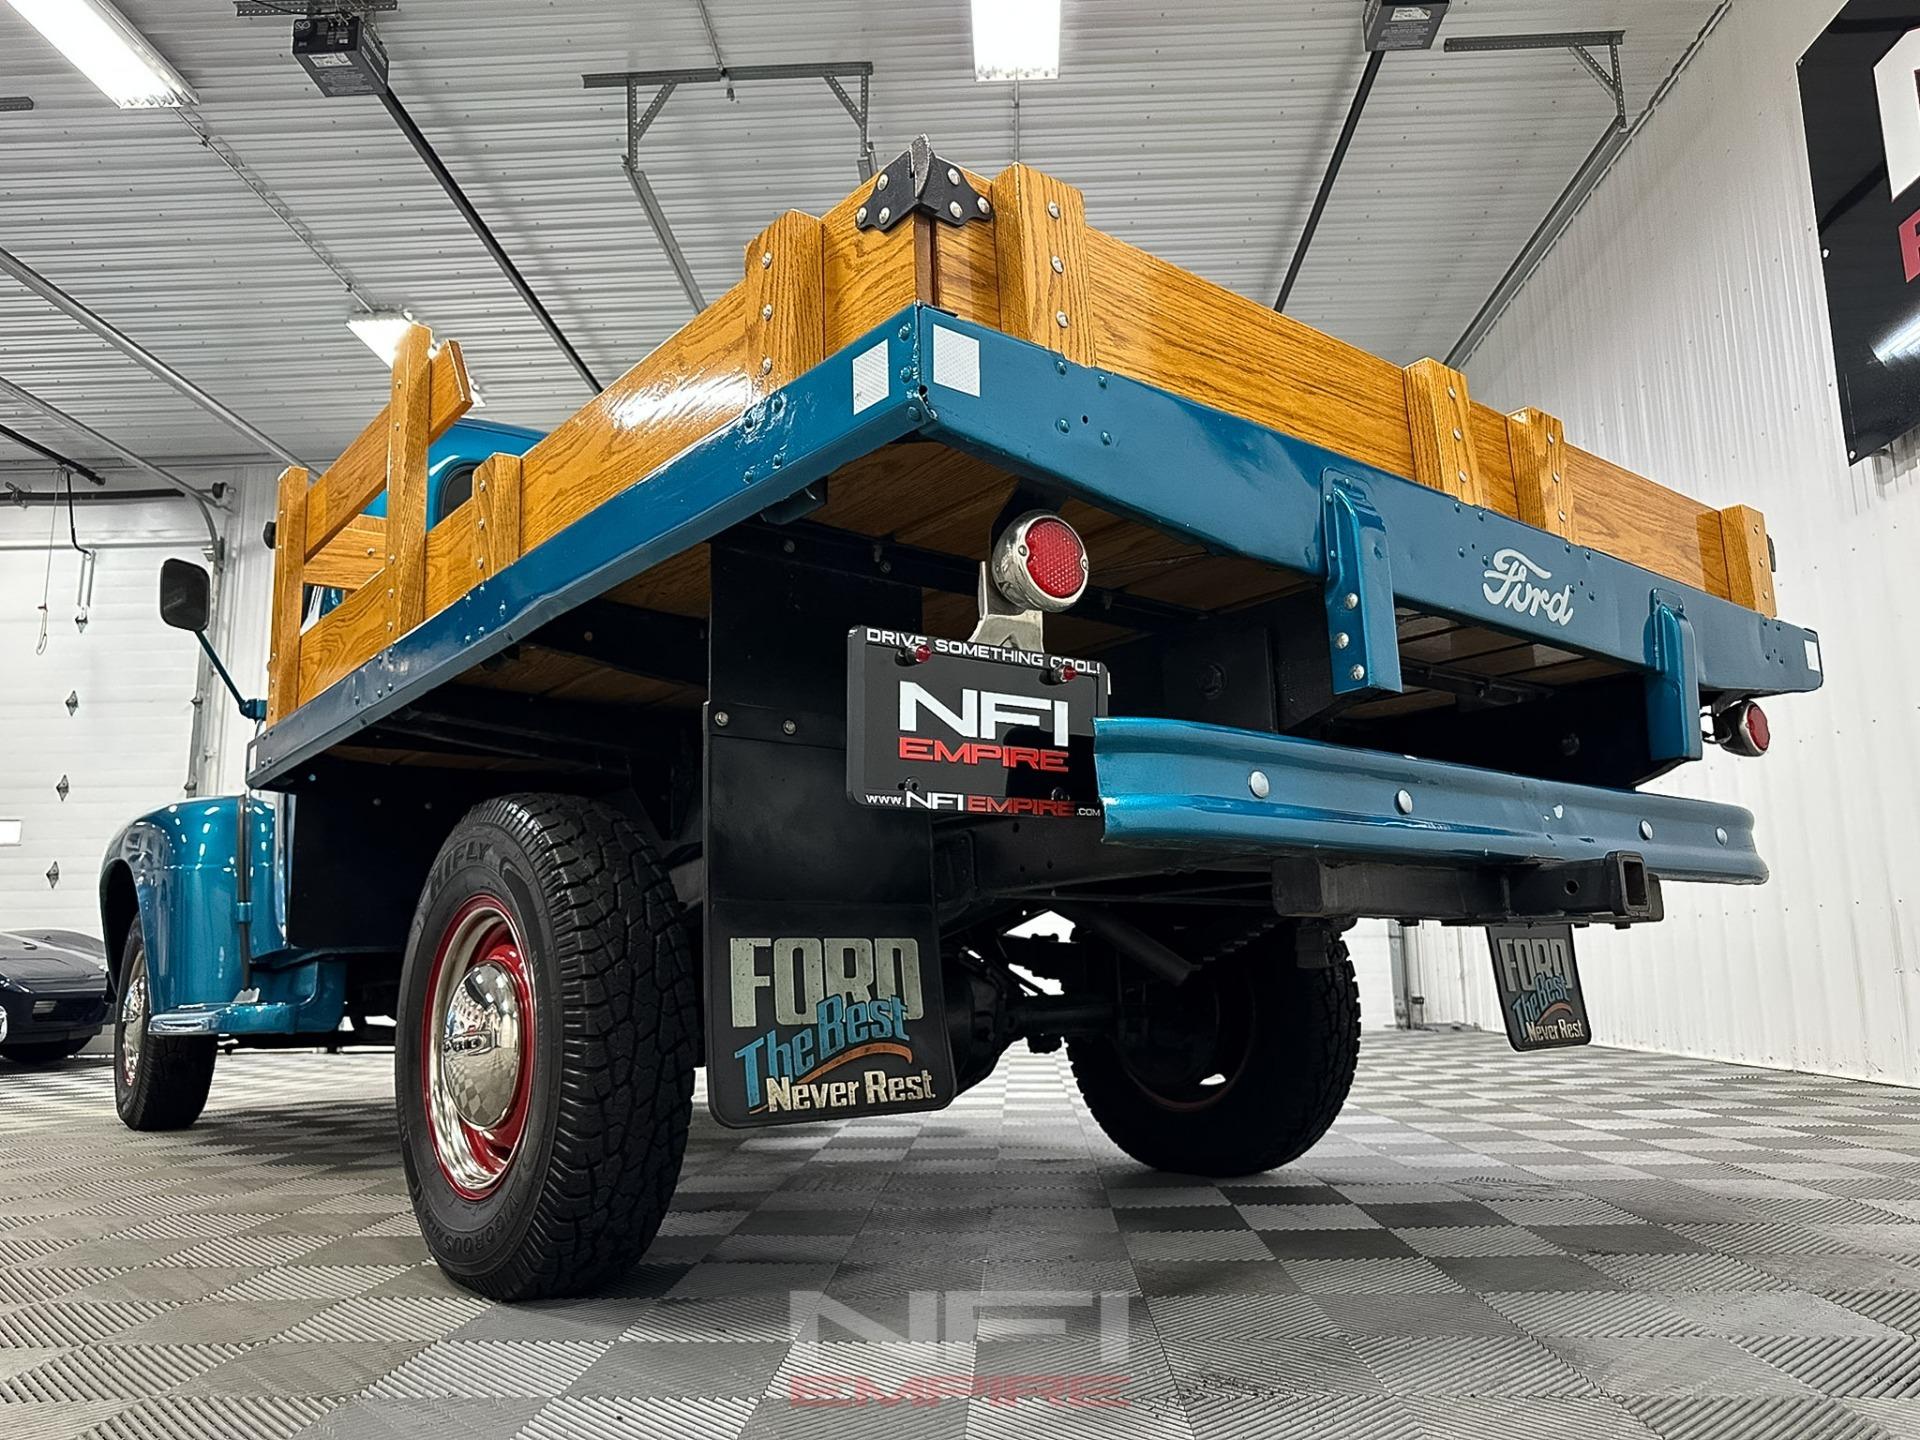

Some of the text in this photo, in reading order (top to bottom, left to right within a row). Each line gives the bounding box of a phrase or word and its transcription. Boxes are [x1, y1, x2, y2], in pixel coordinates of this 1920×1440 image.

[1482, 548, 1574, 626] Ford
[866, 628, 1100, 674] DRIVE SOMETHING COOL!
[899, 680, 1069, 747] NFI
[899, 737, 1069, 773] EMPIRE
[730, 938, 924, 1027] FORD
[1499, 939, 1573, 991] FORD
[1512, 975, 1569, 1041] The Best
[1526, 1021, 1559, 1042] Never
[735, 994, 910, 1108] The Best
[766, 1076, 859, 1112] Never
